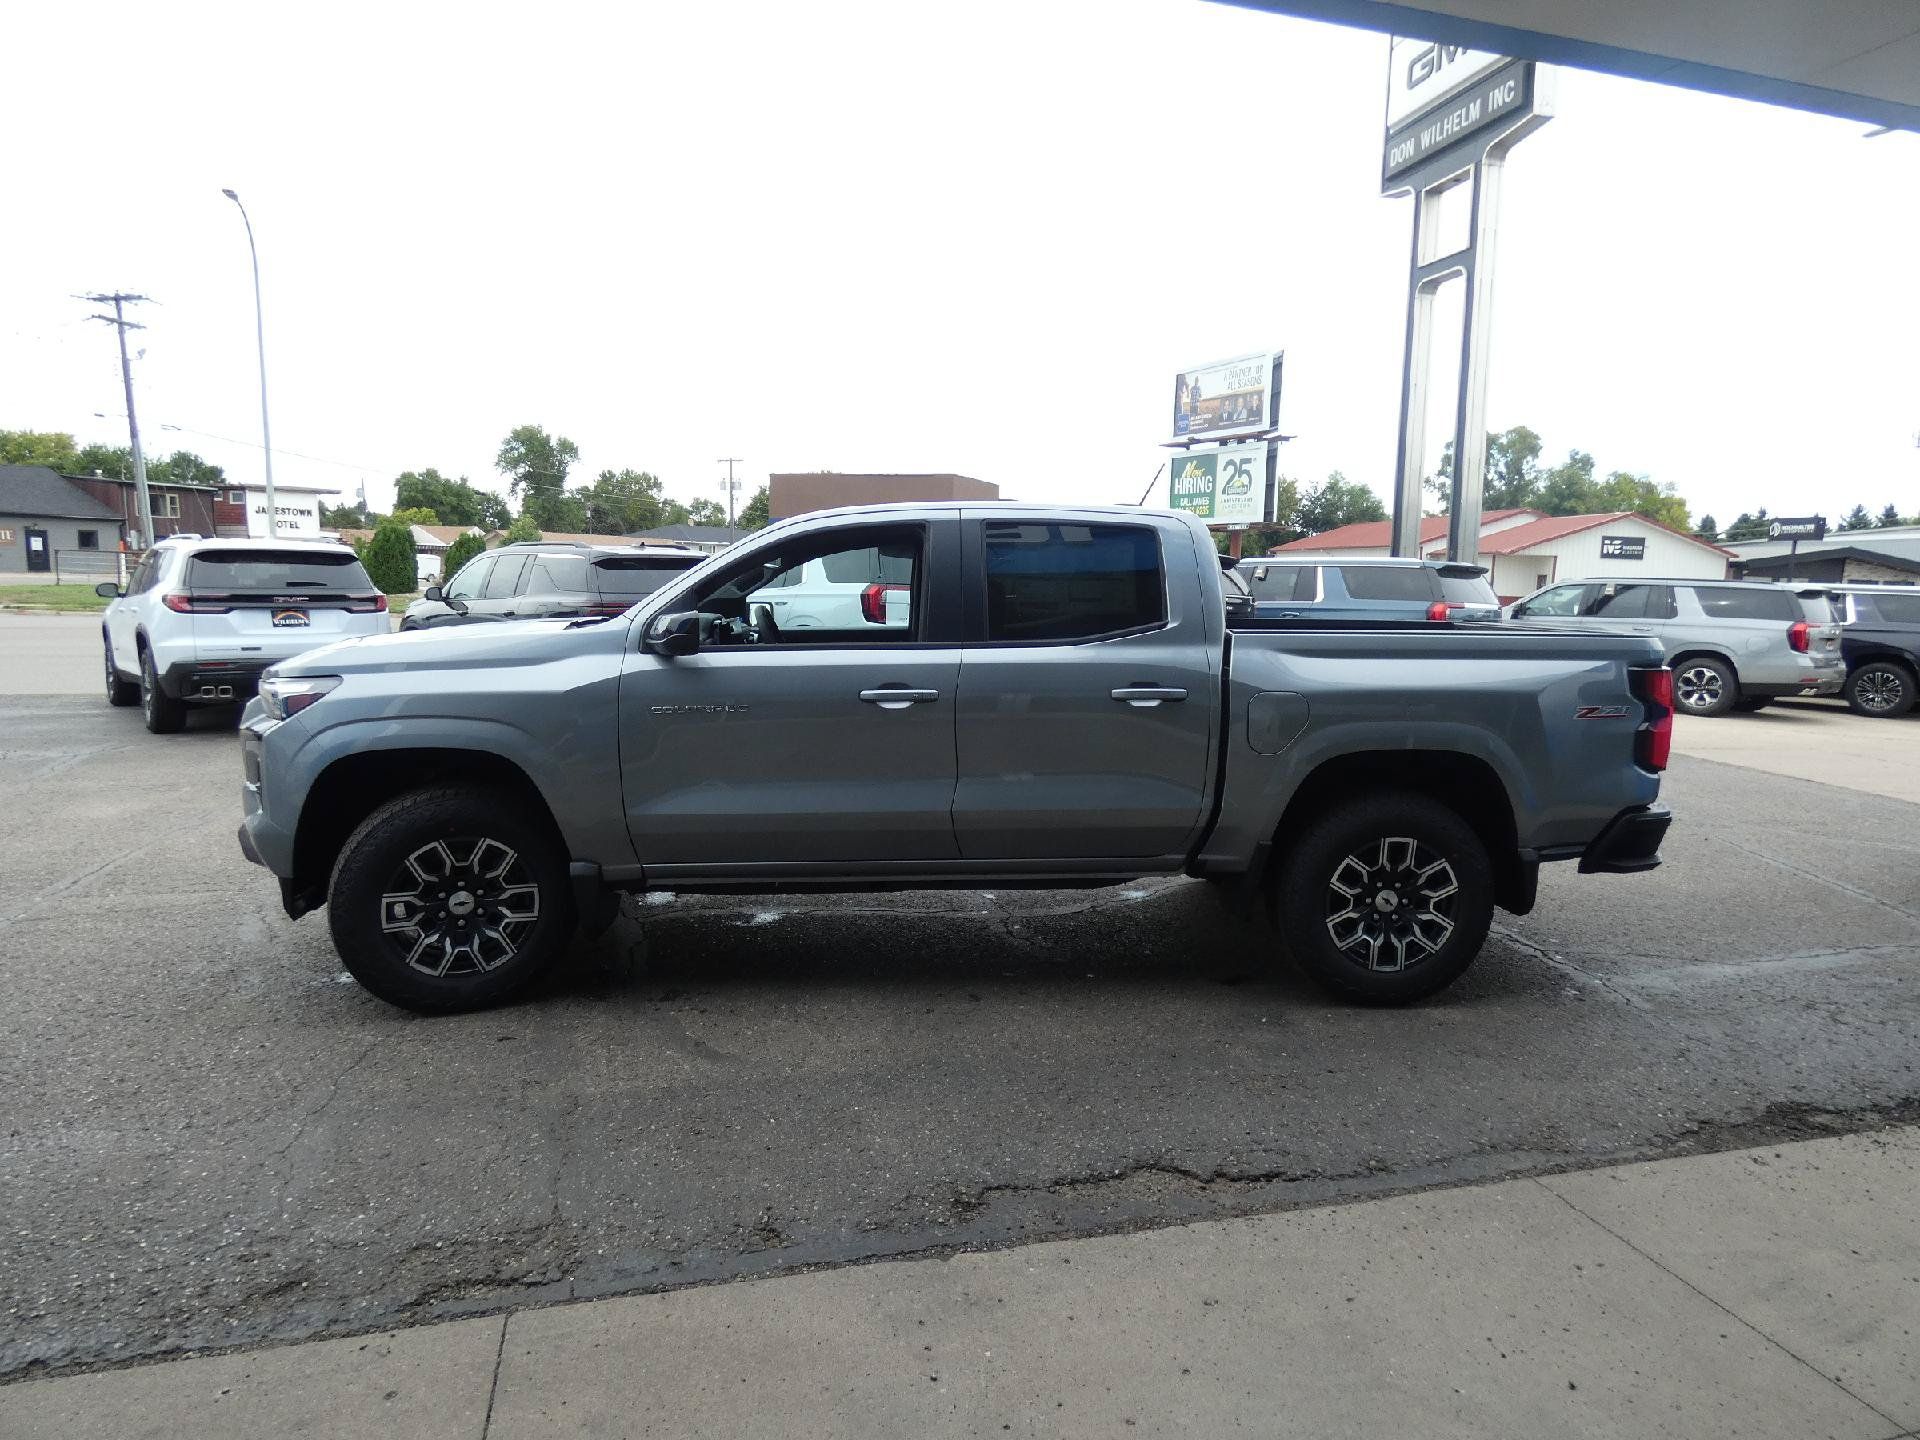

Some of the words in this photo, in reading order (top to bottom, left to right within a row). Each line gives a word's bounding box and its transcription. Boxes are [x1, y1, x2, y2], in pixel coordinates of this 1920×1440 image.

[1390, 138, 1414, 167] DON
[1420, 98, 1481, 150] WILHELM
[1488, 80, 1515, 113] INC
[1174, 475, 1213, 495] HIRING
[1222, 458, 1253, 495] 25
[255, 506, 313, 517] JAESTOWN
[275, 520, 301, 529] OTEL
[1573, 705, 1632, 720] Z71
